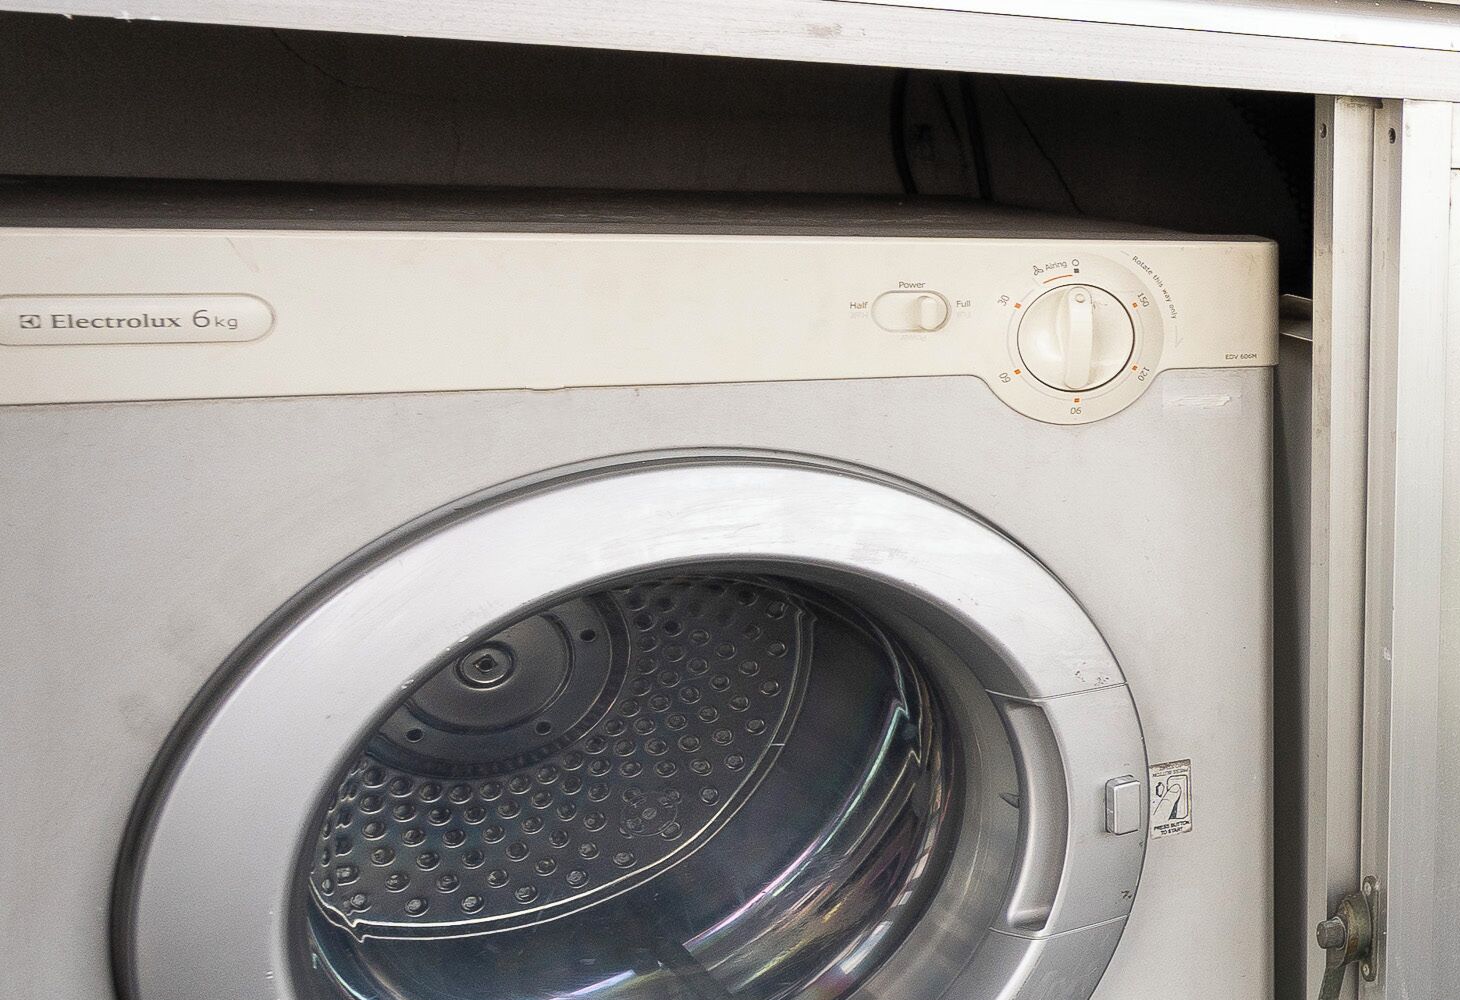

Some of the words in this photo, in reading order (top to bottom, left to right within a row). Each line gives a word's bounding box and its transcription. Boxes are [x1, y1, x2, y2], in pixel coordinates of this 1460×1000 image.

[1045, 260, 1067, 271] Airing
[898, 281, 926, 289] Power
[1132, 255, 1153, 275] Rotate
[1153, 274, 1164, 288] this
[1162, 288, 1172, 302] way
[1169, 303, 1178, 319] only
[849, 301, 869, 309] Half
[956, 300, 971, 308] Full
[997, 294, 1010, 307] 30
[1137, 292, 1150, 308] 150
[51, 313, 182, 329] Electrolux
[1137, 366, 1150, 382] 120
[1153, 823, 1169, 831] PRESS
[1170, 820, 1190, 828] BUTTON
